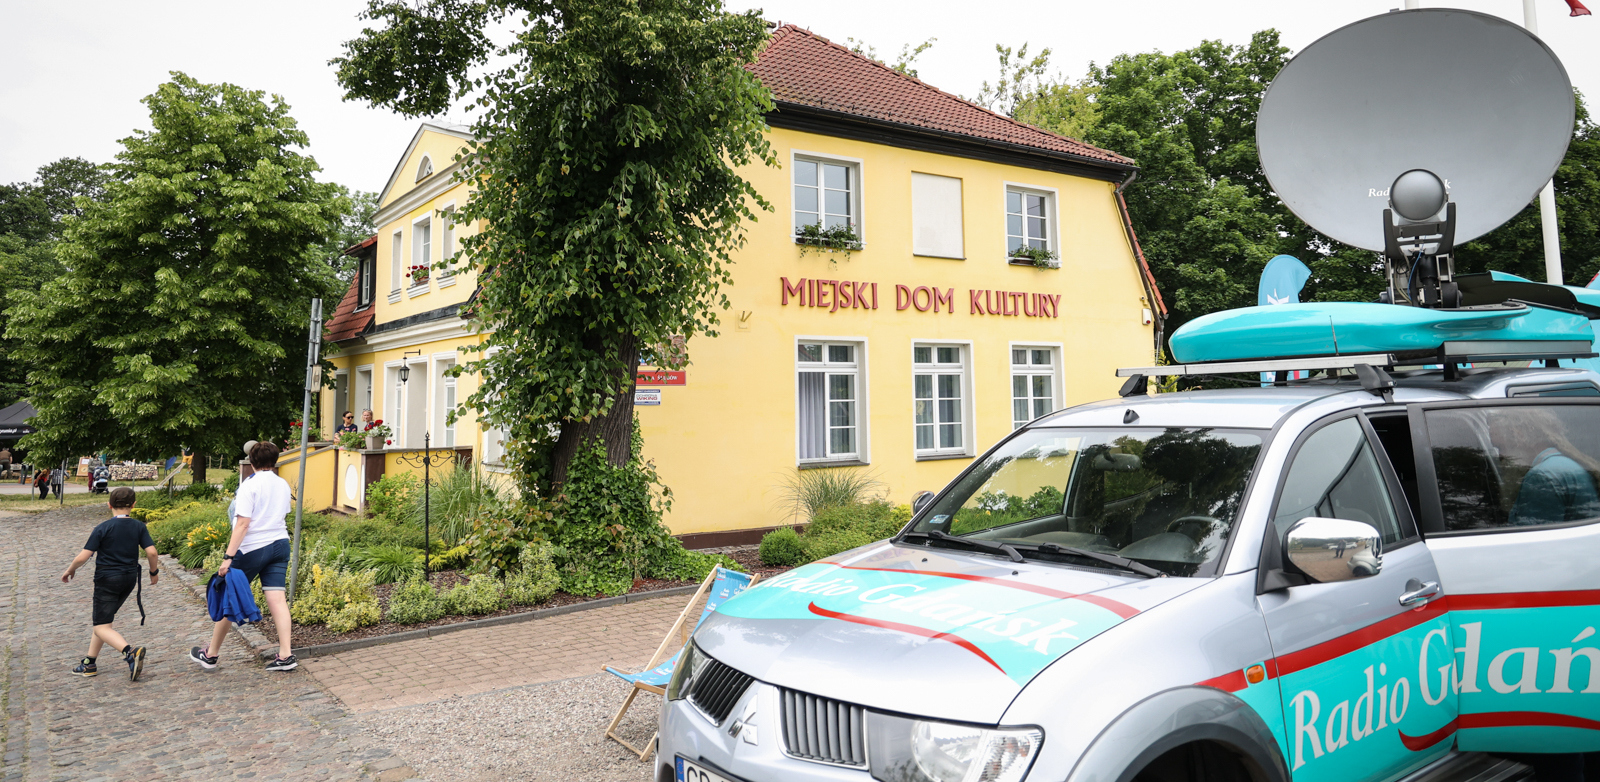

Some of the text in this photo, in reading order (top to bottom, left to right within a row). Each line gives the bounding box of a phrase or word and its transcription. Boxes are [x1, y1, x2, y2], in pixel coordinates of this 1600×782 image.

[1368, 187, 1390, 197] Rad
[780, 277, 1062, 318] MIEJSKI DOM KULTURY
[759, 572, 1079, 656] Radio Gdańsk
[1289, 662, 1410, 772] Radio
